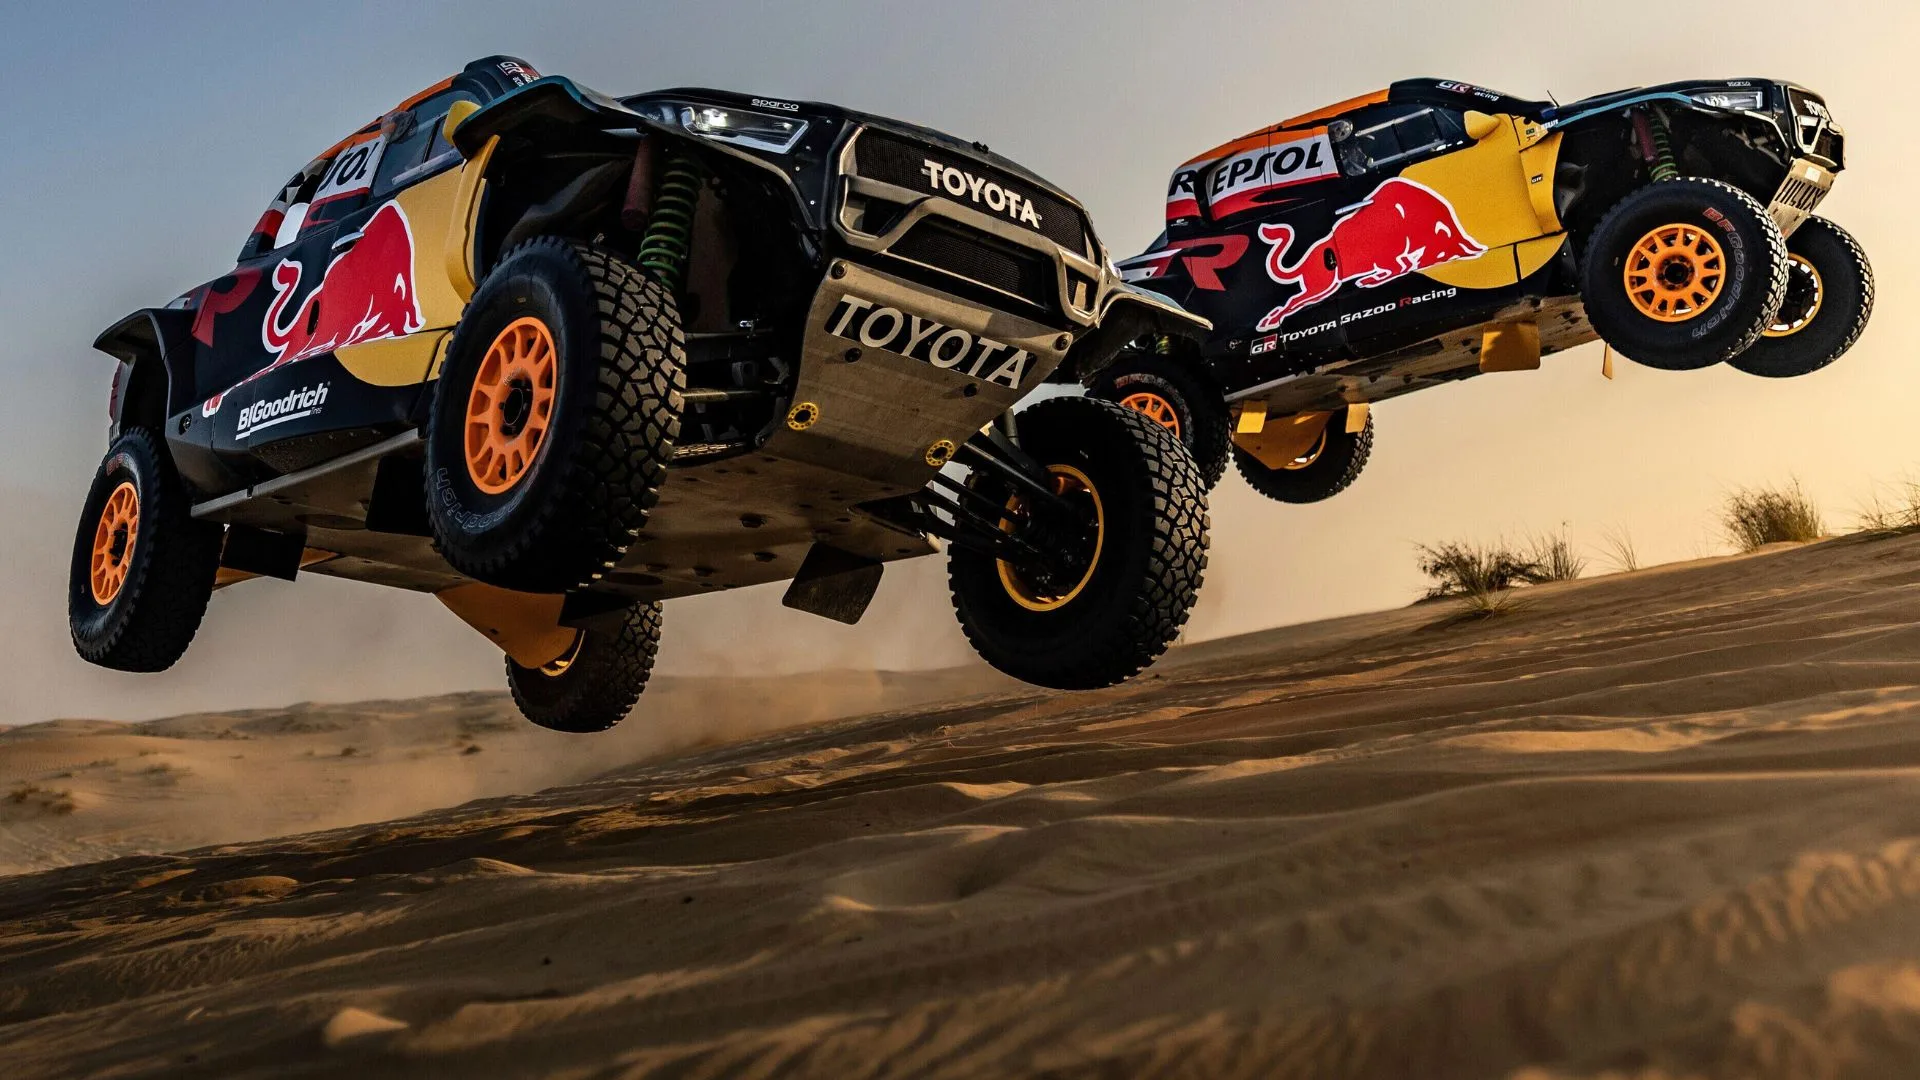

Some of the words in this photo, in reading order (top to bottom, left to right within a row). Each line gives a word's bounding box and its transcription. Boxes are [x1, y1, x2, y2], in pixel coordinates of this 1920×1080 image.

[1439, 80, 1470, 92] GR
[924, 159, 1040, 229] TOYOTA
[831, 294, 1020, 389] TOYOTA
[1251, 337, 1277, 355] GR
[1279, 320, 1337, 344] TOYOTA
[1340, 302, 1396, 325] GAZOO
[1400, 287, 1457, 307] Racing
